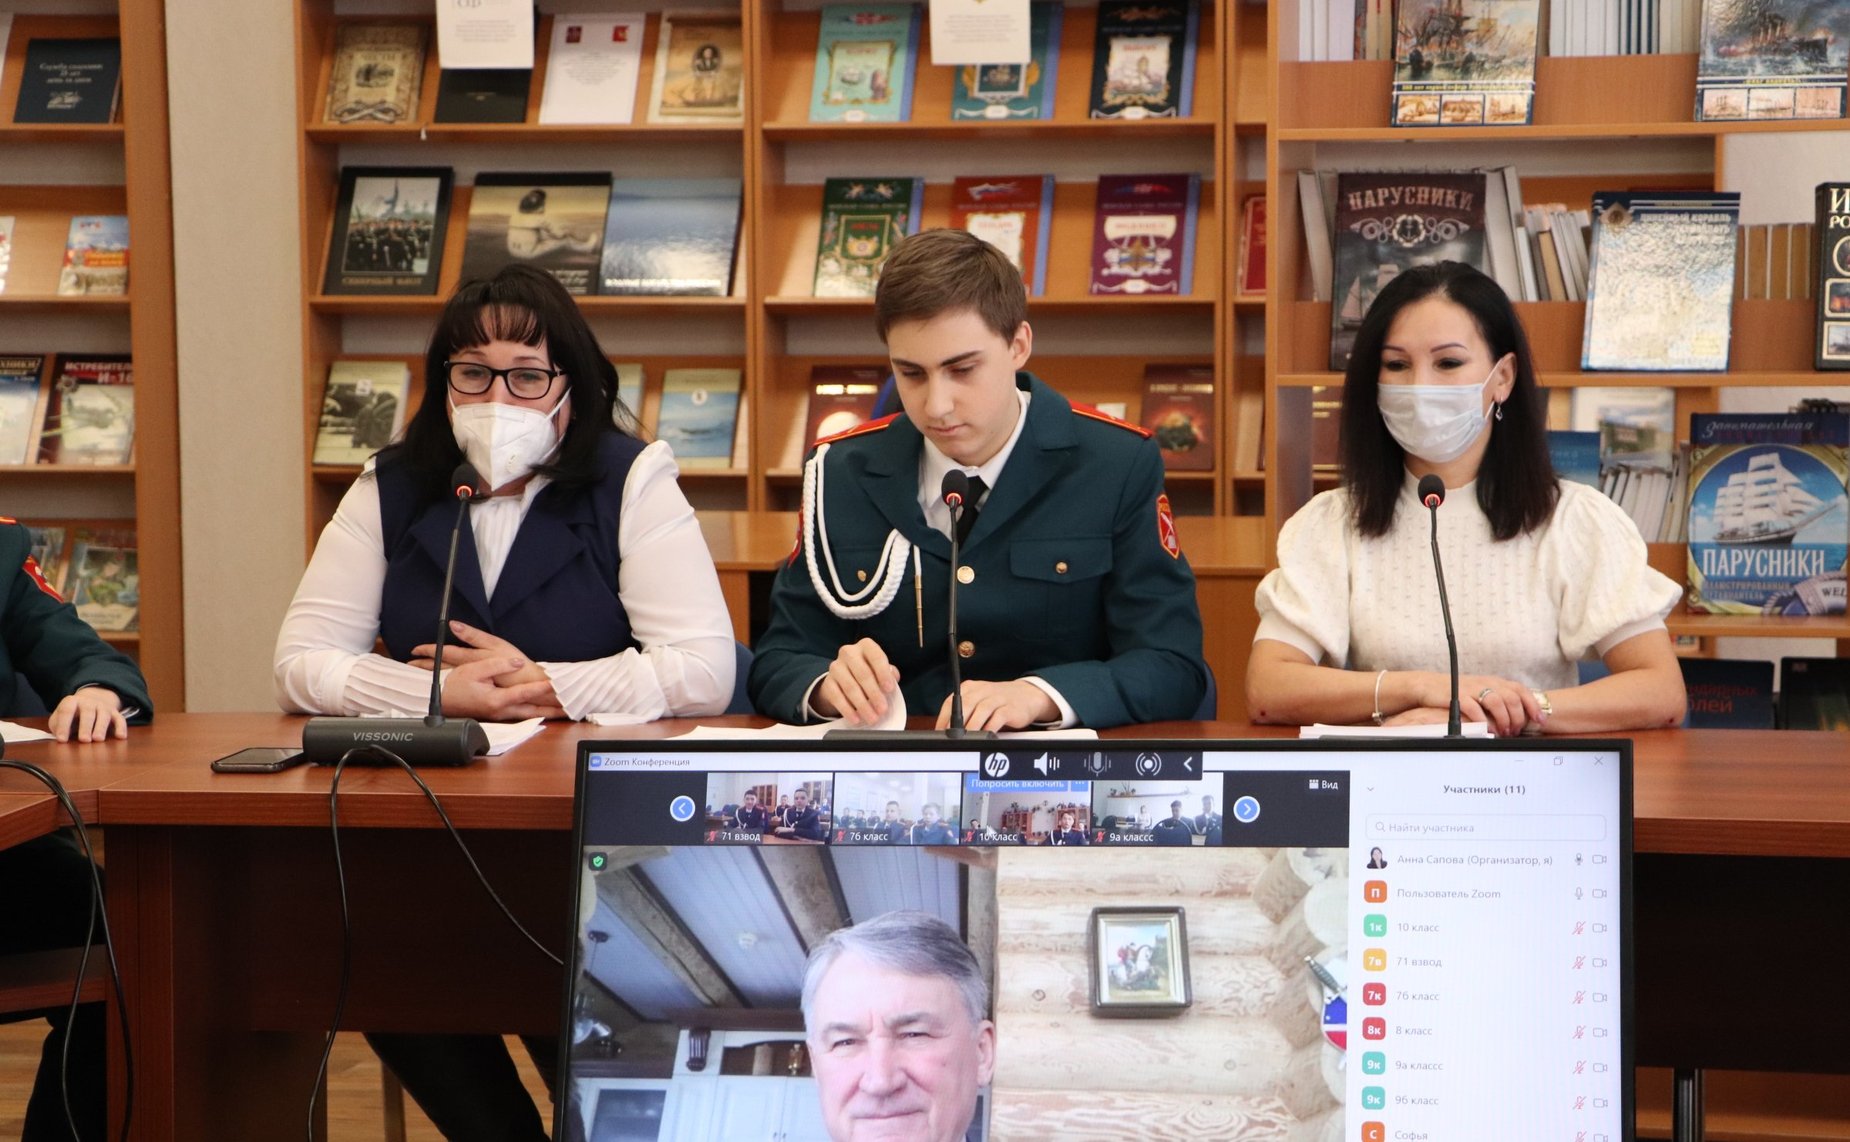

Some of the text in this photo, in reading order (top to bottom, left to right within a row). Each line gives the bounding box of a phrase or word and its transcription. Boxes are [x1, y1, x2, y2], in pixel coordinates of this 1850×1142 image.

[1348, 185, 1473, 212] ПАРУСНИКИ
[1703, 549, 1825, 577] ПАРУСНИКИ
[353, 732, 413, 742] VISSONIC
[604, 757, 690, 768] Zoom Конференция
[1321, 780, 1339, 790] Вид
[1443, 785, 1526, 796] Участники (11)
[1388, 823, 1474, 836] Найти участника
[722, 831, 761, 842] 71 взвод
[863, 833, 888, 842] класс
[992, 832, 1018, 842] класс
[1109, 832, 1154, 842] 9а классс
[1398, 854, 1554, 867] Анна Сапова (Организатор, я)
[1397, 889, 1502, 899] Пользователь Zoom
[1398, 923, 1440, 932] 10 класс
[1396, 957, 1442, 968] 71 взвод
[1412, 992, 1440, 1001] класс
[1396, 1026, 1432, 1036] 8 класс
[1395, 1061, 1444, 1070] 9а классс
[1410, 1096, 1439, 1106] класс
[1394, 1131, 1428, 1142] Софья
